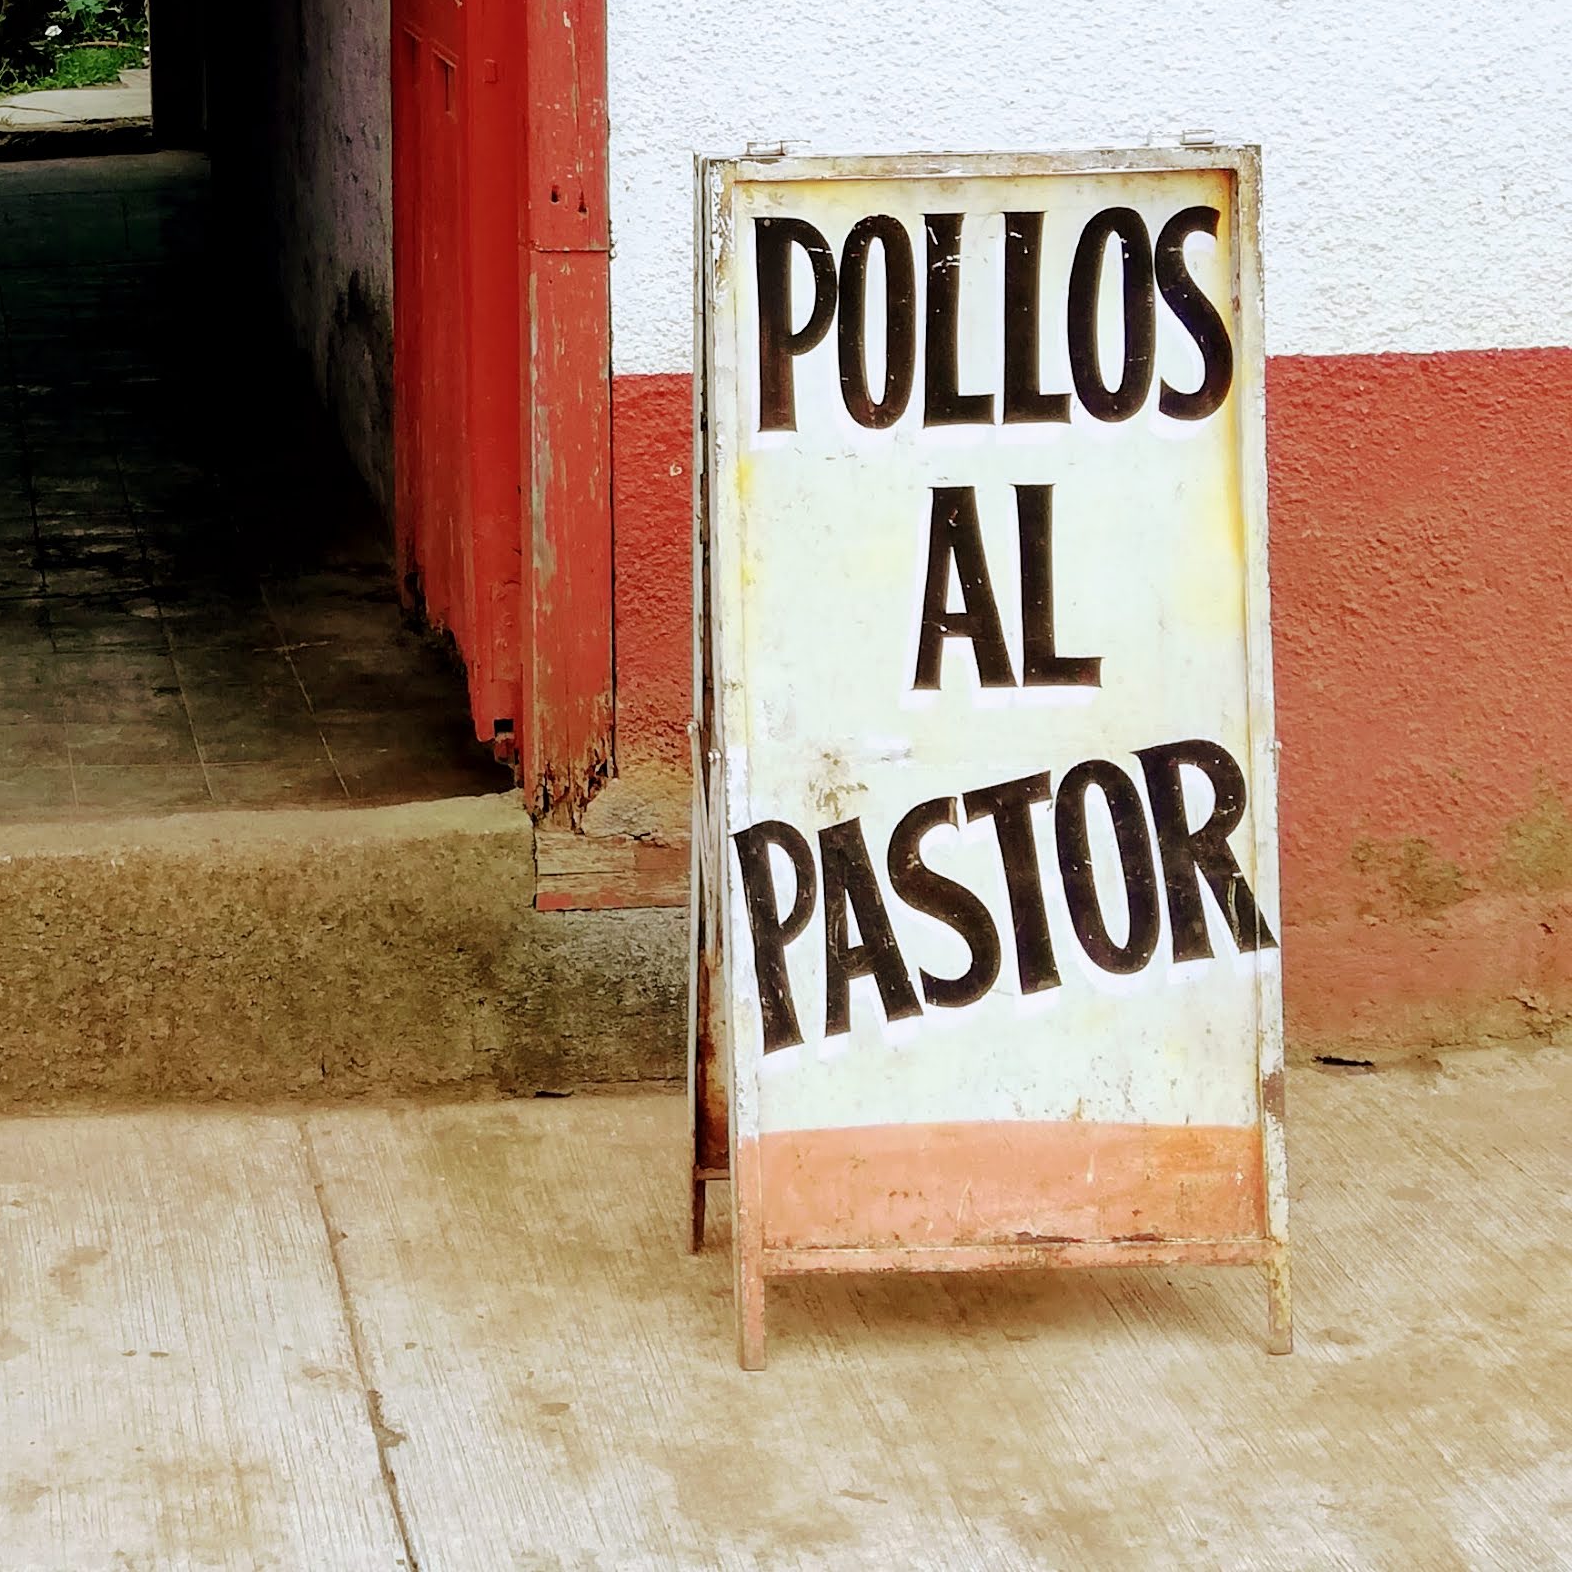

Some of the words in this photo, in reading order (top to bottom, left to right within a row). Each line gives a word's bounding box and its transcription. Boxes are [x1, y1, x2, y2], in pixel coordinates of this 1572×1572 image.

[754, 204, 1234, 431] POLLOS
[912, 484, 1102, 691] AL
[732, 738, 1280, 1056] PASTOR
